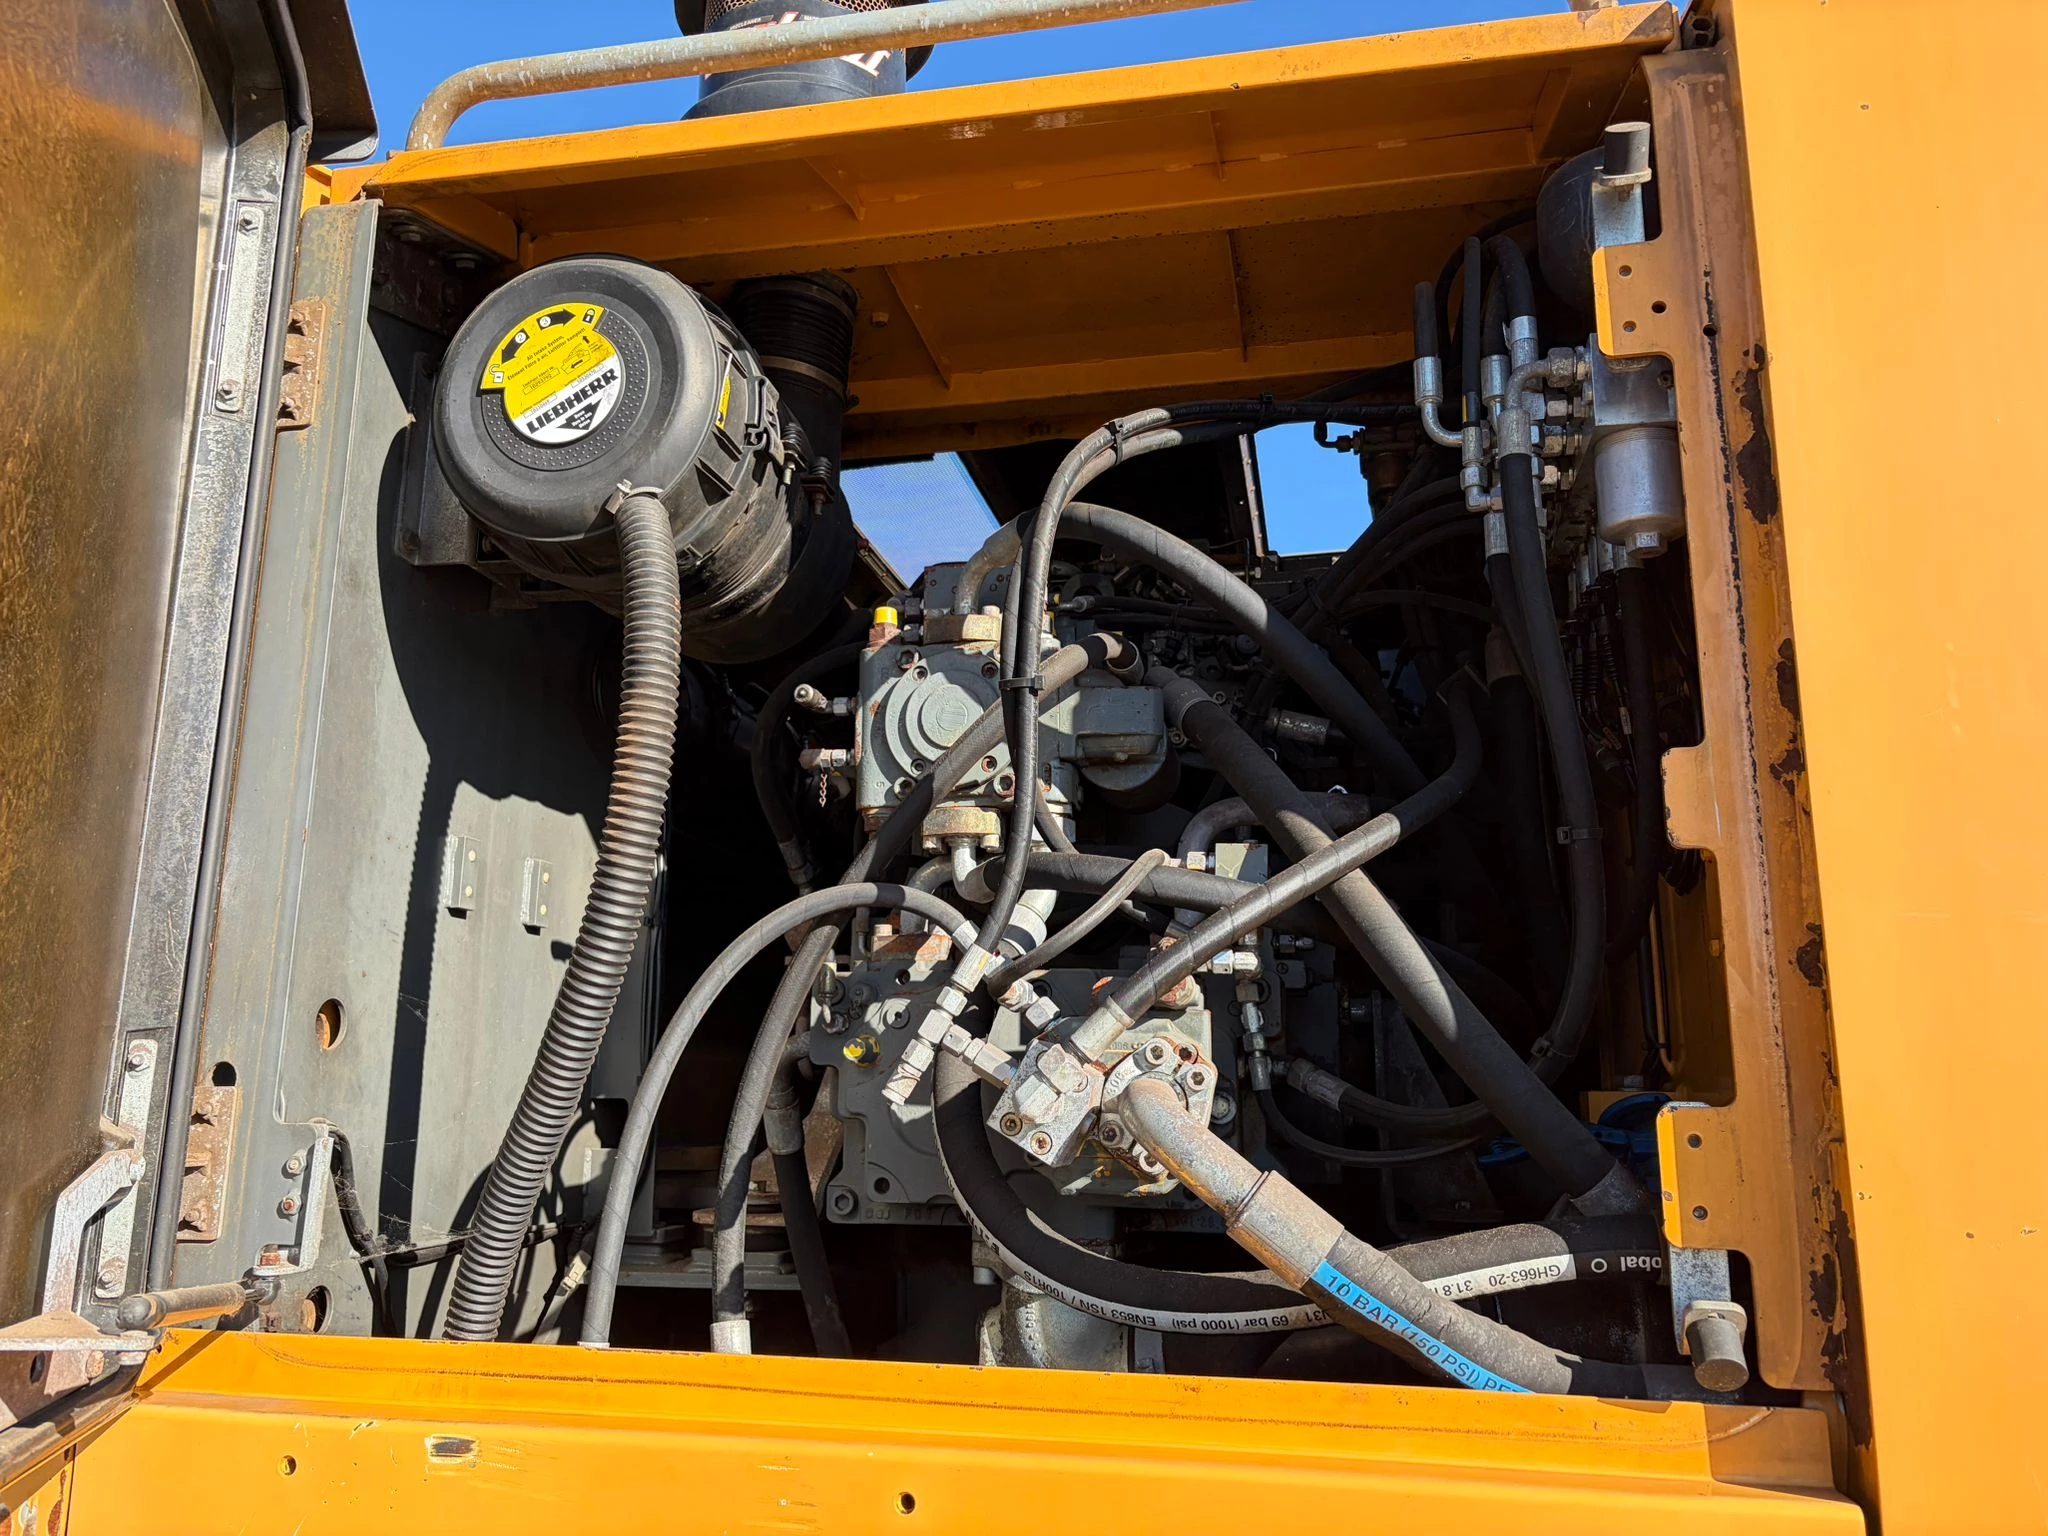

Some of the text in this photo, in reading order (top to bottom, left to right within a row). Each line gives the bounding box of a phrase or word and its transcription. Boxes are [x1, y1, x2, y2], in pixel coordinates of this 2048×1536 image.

[526, 368, 619, 434] LIEBHERR
[1488, 1263, 1562, 1288] GH663-20
[1022, 1269, 1067, 1302] 100R1S
[1443, 1280, 1473, 1297] 31.8
[1079, 1298, 1107, 1316] 1SN
[1111, 1308, 1157, 1328] EN853
[1171, 1317, 1198, 1331] psi)
[1200, 1318, 1240, 1331] (1000
[1244, 1316, 1268, 1329] bar
[1271, 1314, 1289, 1328] 69
[1326, 1273, 1351, 1298] 10
[1353, 1292, 1399, 1330] BAR
[1400, 1324, 1441, 1359] (150
[1440, 1353, 1481, 1386] PSI)
